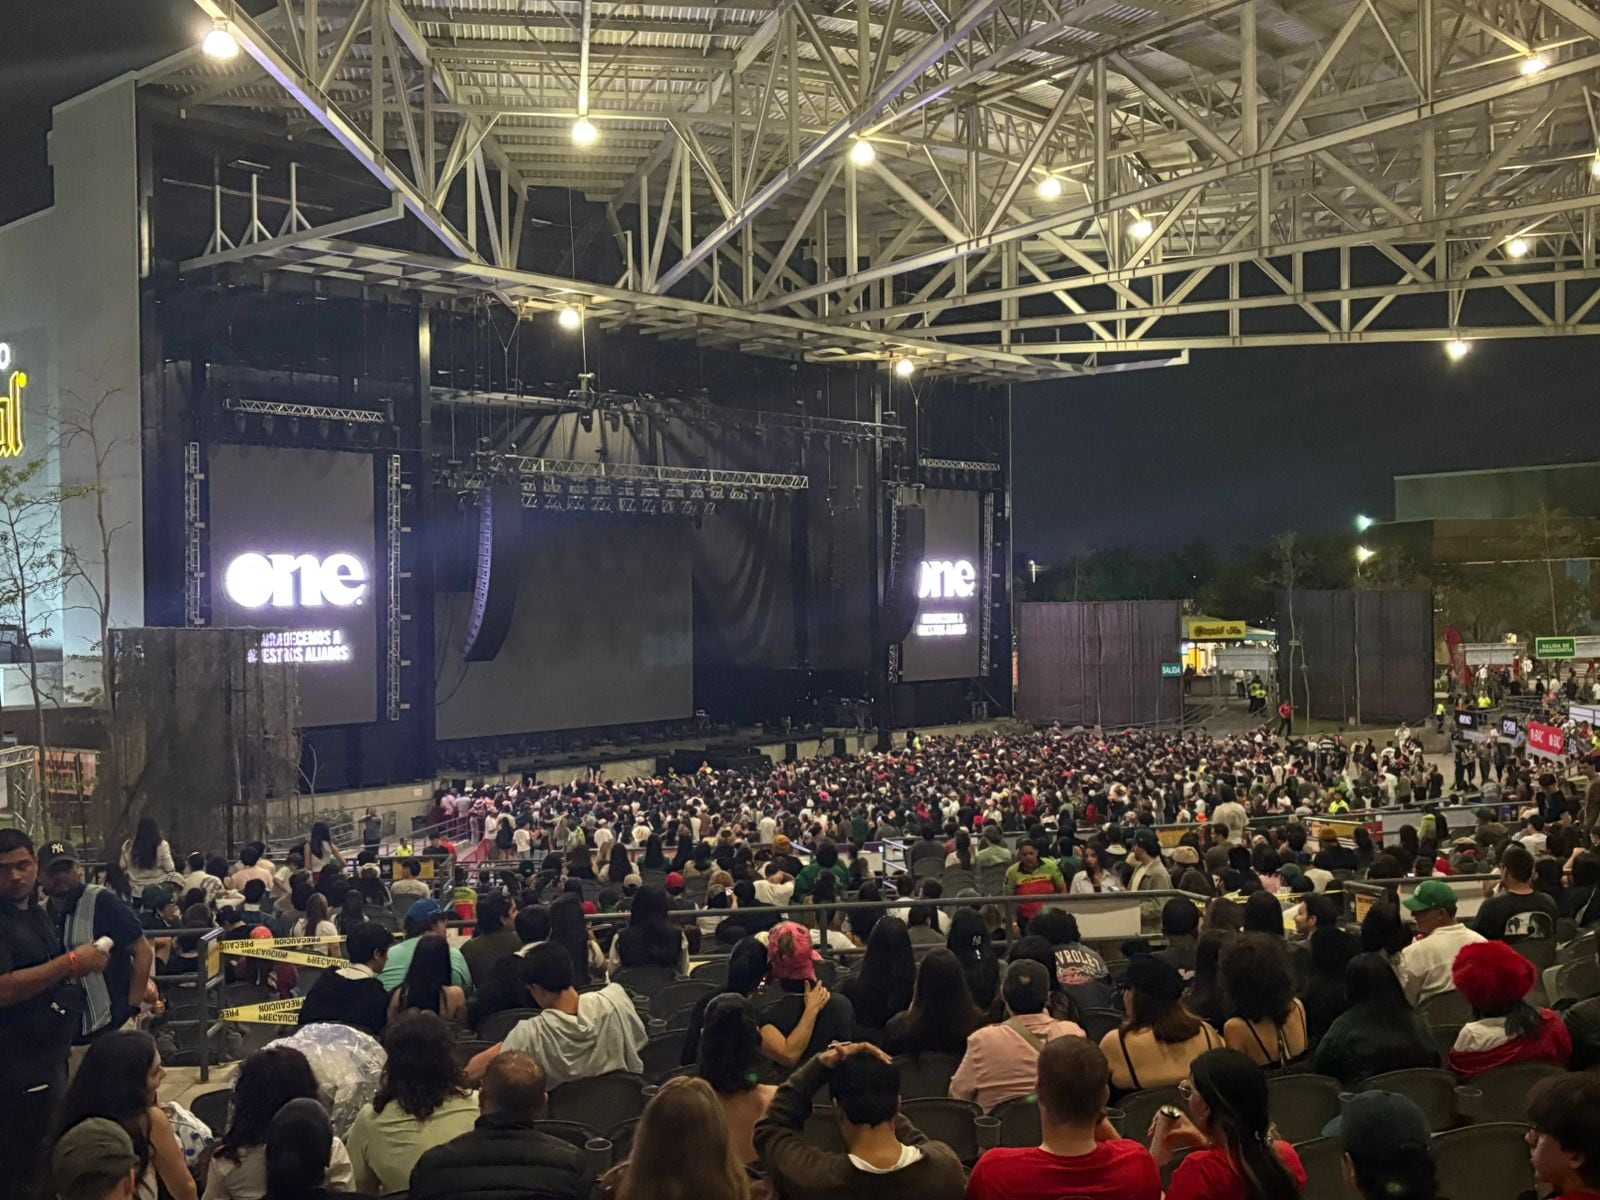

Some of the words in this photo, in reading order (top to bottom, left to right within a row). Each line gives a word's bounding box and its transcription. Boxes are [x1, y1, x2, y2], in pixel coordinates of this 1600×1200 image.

[256, 631, 331, 646] GRADECEMOS
[1162, 666, 1180, 674] SALIDA
[219, 940, 254, 950] PRECAUC
[1055, 949, 1102, 972] VROLET
[219, 1009, 239, 1018] PREC
